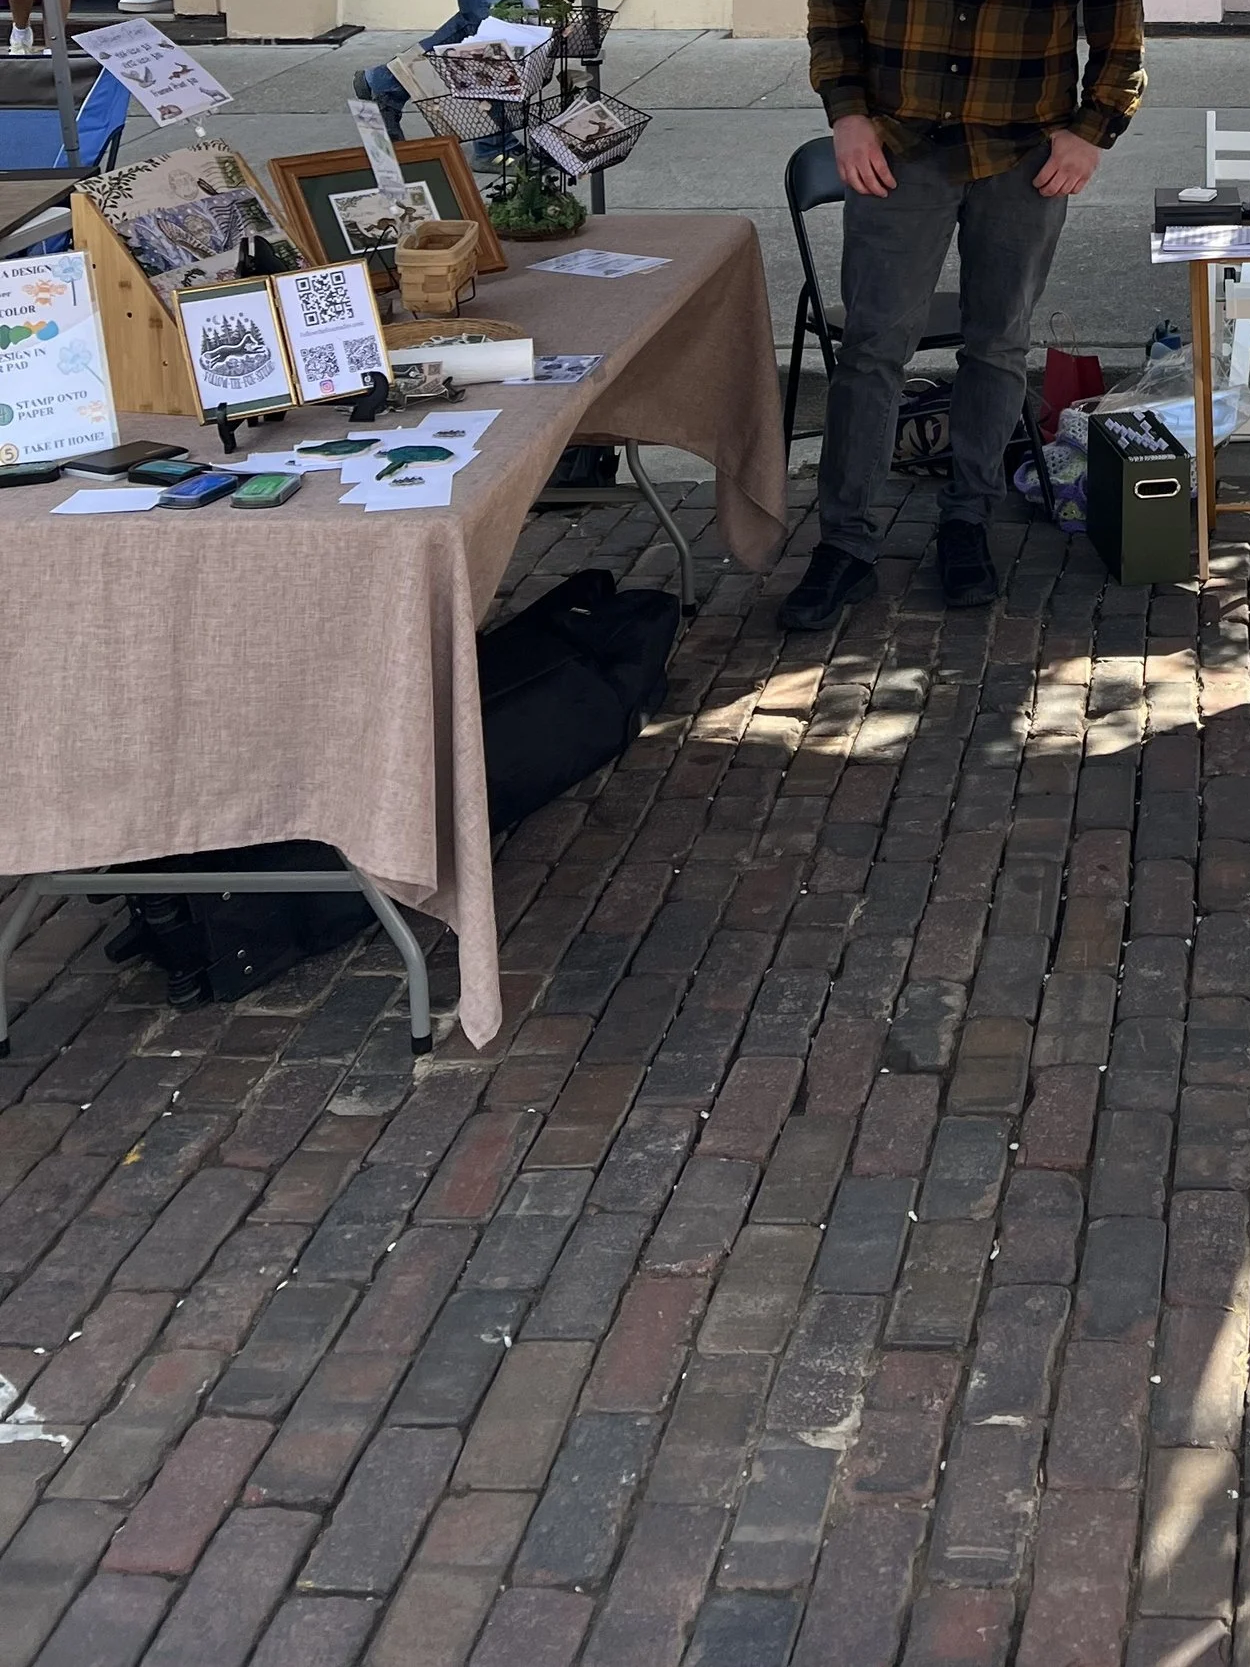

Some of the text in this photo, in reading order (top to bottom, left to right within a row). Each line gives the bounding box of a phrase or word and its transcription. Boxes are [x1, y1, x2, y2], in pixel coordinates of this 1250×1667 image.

[12, 264, 52, 278] DESIGN
[34, 348, 46, 357] IN
[7, 361, 28, 373] PAD
[16, 390, 87, 410] STAMP ONTO
[18, 407, 54, 421] PAPER
[24, 431, 105, 455] TAKE IT HOME!
[4, 448, 14, 460] 5
